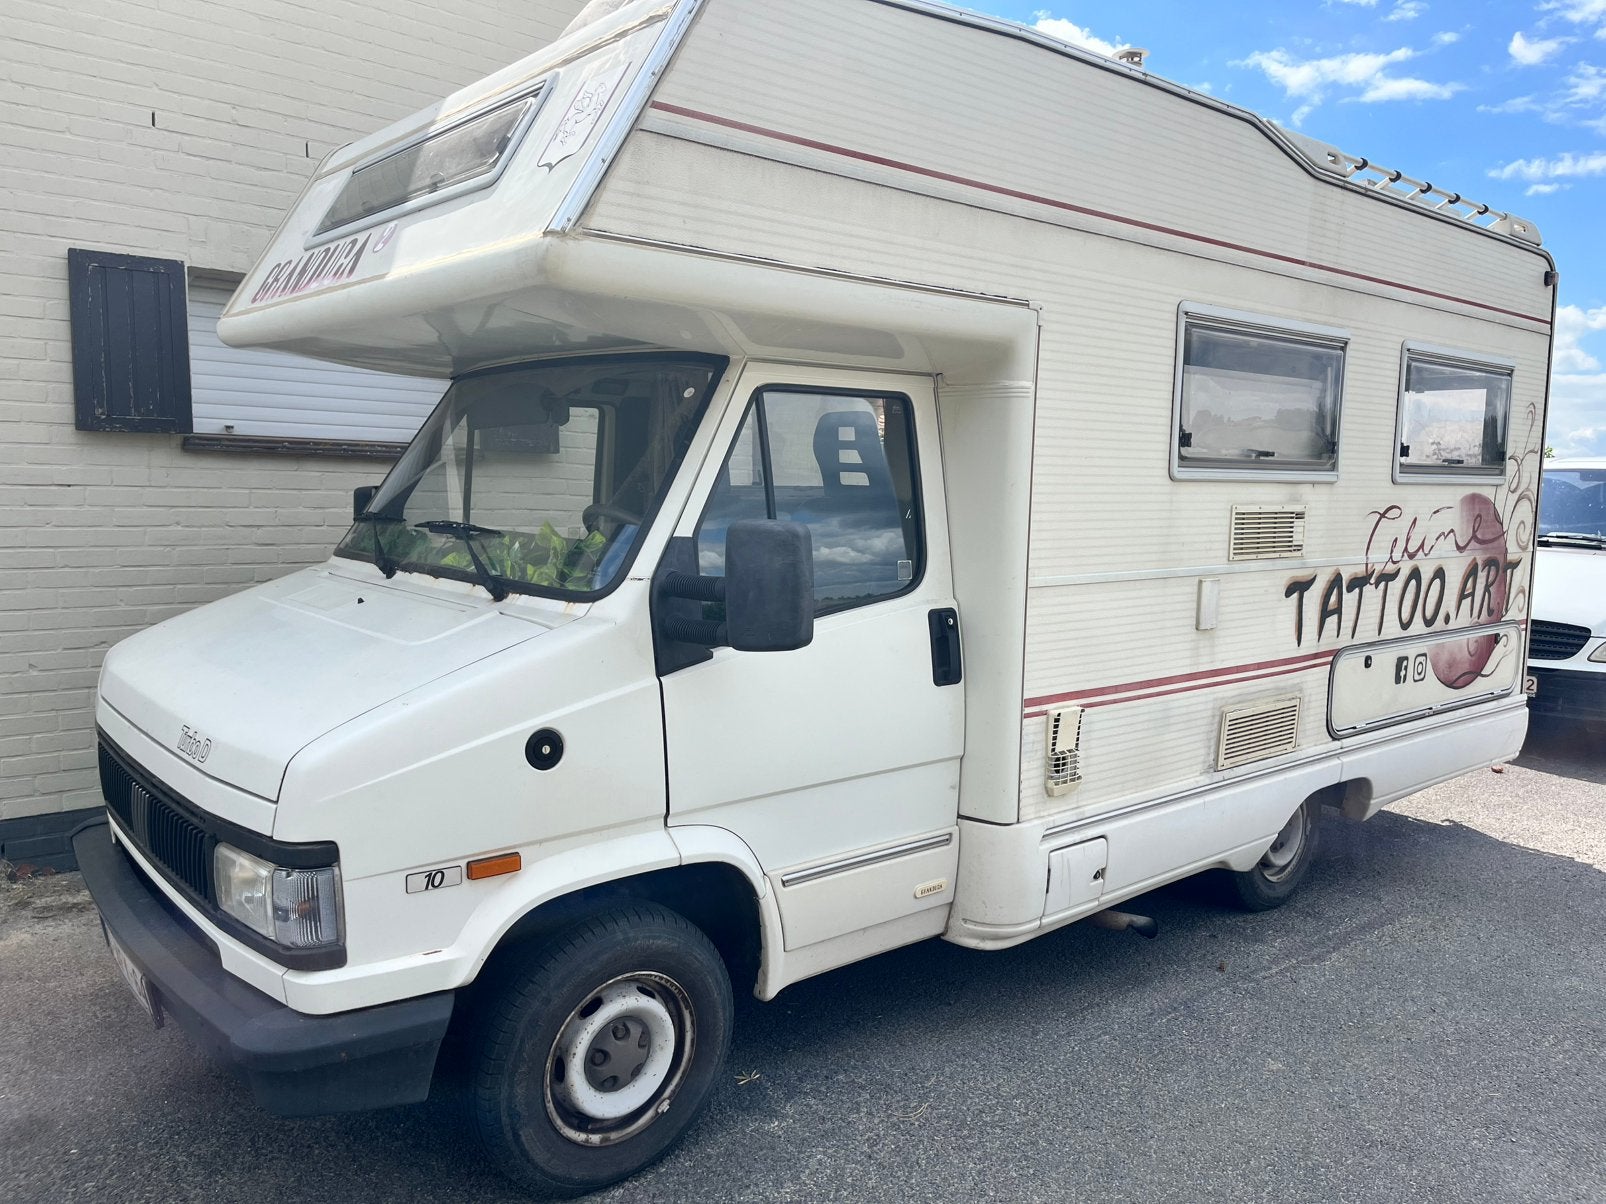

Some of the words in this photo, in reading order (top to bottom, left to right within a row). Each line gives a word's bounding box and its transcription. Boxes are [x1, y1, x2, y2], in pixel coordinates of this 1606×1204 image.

[250, 232, 373, 304] GRANDUCA
[1285, 556, 1523, 648] TATTOO.ART
[424, 870, 445, 890] 10
